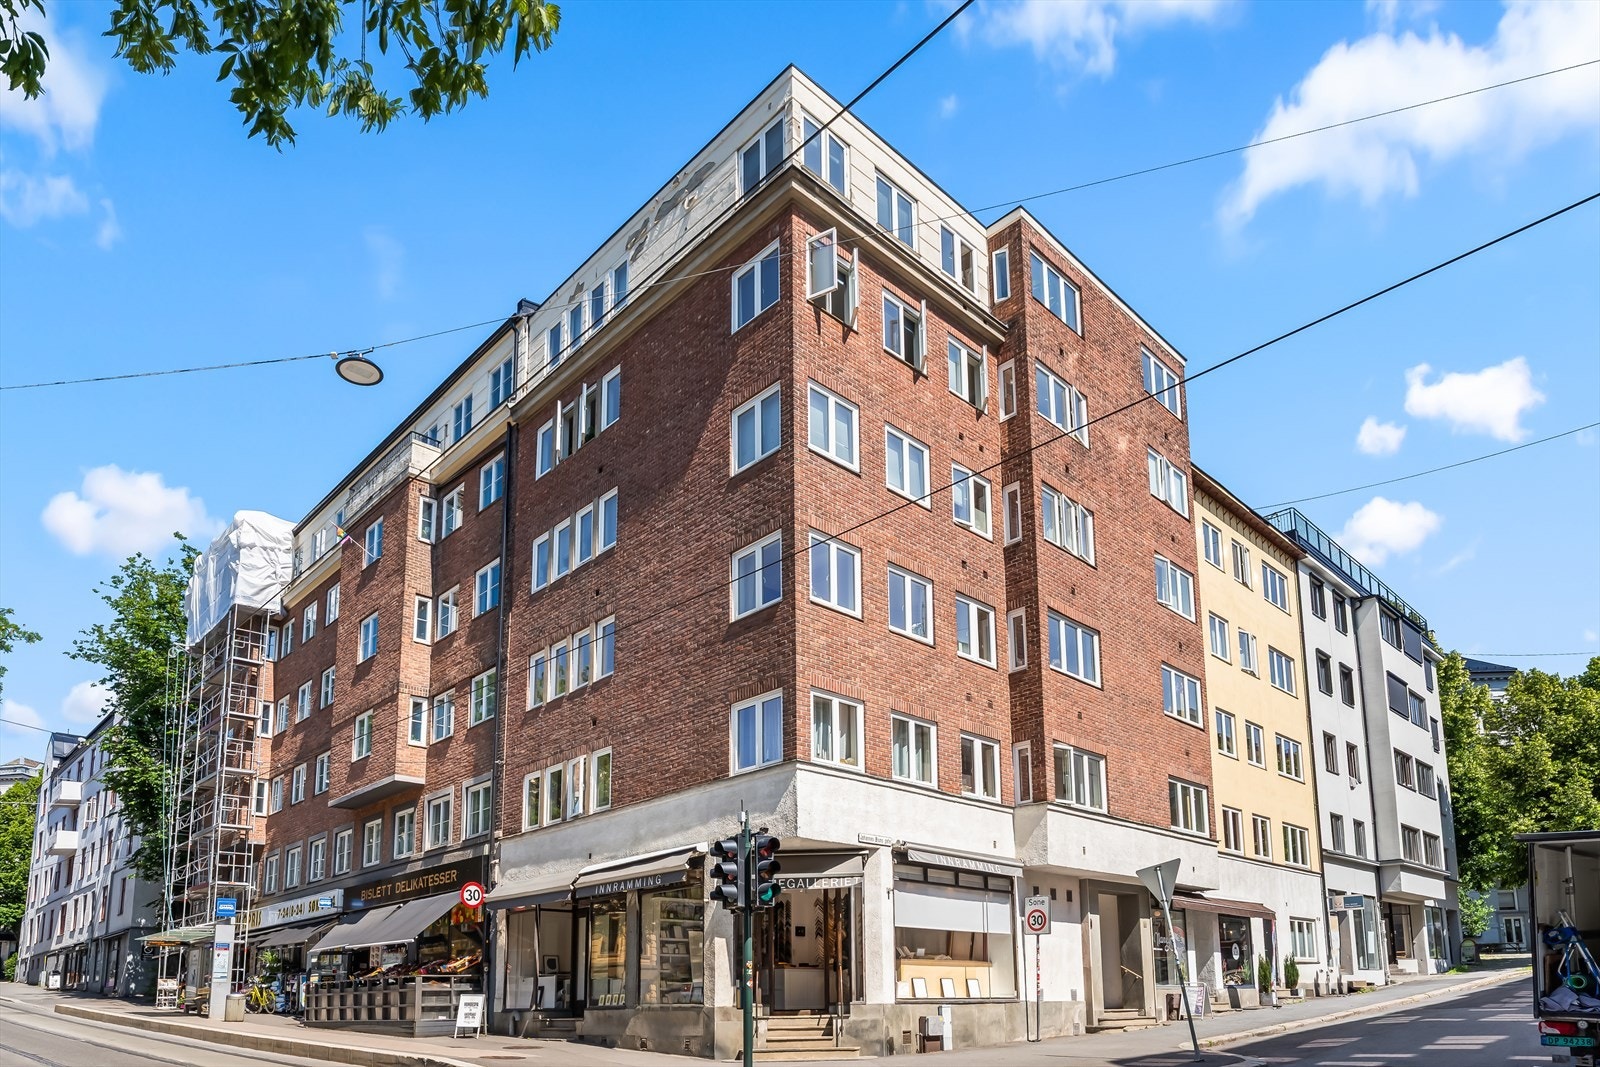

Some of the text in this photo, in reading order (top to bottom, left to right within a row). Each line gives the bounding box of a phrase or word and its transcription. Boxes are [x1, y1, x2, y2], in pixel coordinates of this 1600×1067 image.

[935, 855, 1001, 873] INNRAMMING
[361, 869, 457, 900] BISLETT DELIKATESSER
[595, 875, 662, 894] INNRAMMING
[777, 877, 862, 889] EGALLERIET
[465, 889, 480, 902] 30
[1031, 915, 1043, 926] 30
[1548, 1037, 1559, 1045] DP
